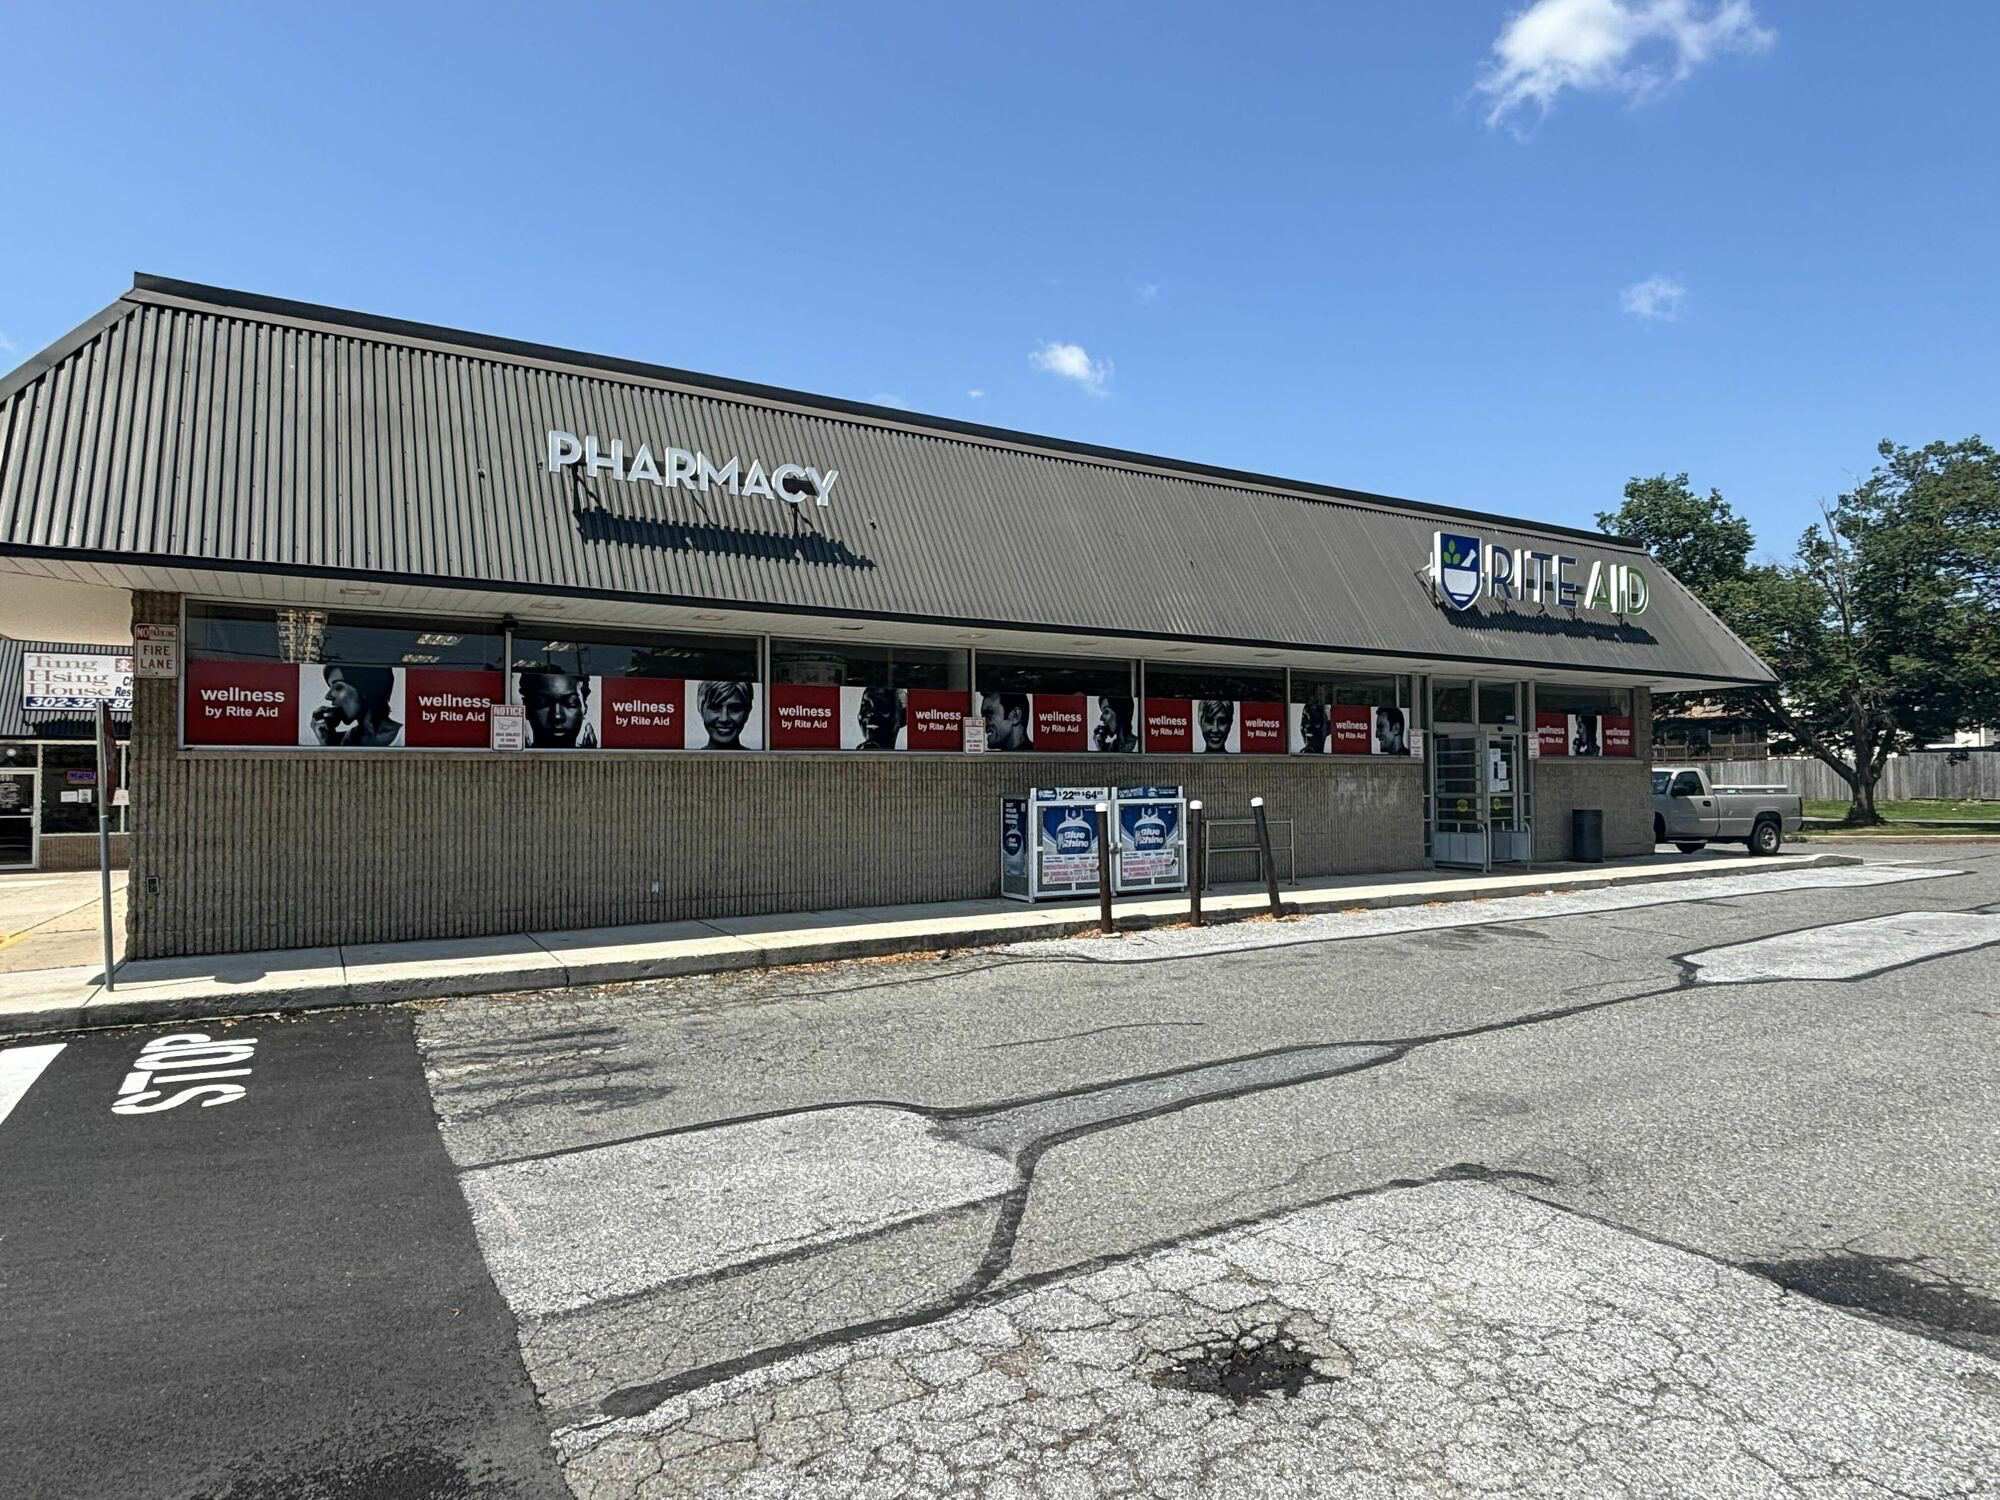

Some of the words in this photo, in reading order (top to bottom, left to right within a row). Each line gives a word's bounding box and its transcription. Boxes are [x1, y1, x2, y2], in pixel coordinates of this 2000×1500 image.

[548, 430, 839, 507] PHARMACY
[1485, 544, 1578, 608] RITE
[1584, 561, 1649, 616] AID
[137, 626, 149, 639] NO
[143, 645, 170, 656] FIRE
[27, 655, 98, 672] Tung
[140, 659, 173, 669] LANE
[28, 670, 109, 686] Hsing
[28, 683, 113, 697] House
[200, 686, 285, 702] wellness
[419, 694, 491, 708] wellness
[612, 700, 675, 714] wellness
[206, 706, 222, 719] by
[227, 707, 252, 717] Rite
[256, 708, 279, 718] Aid
[423, 711, 437, 724] by
[441, 712, 463, 722] Rite
[466, 713, 486, 723] Aid
[494, 707, 524, 716] NOTICE
[778, 705, 832, 718] wellness
[915, 709, 962, 721] wellness
[1039, 711, 1082, 723] wellness
[615, 716, 628, 728] by
[631, 717, 650, 726] Rite
[653, 717, 670, 726] Aid
[782, 720, 792, 730] by
[795, 720, 811, 729] Rite
[813, 720, 828, 729] Aid
[917, 723, 927, 732] by
[929, 723, 944, 731] Rite
[945, 723, 958, 731] Aid
[1149, 716, 1188, 726] wellness
[1245, 718, 1280, 728] wellness
[1336, 721, 1368, 731] wellness
[111, 1033, 258, 1114] STOP
